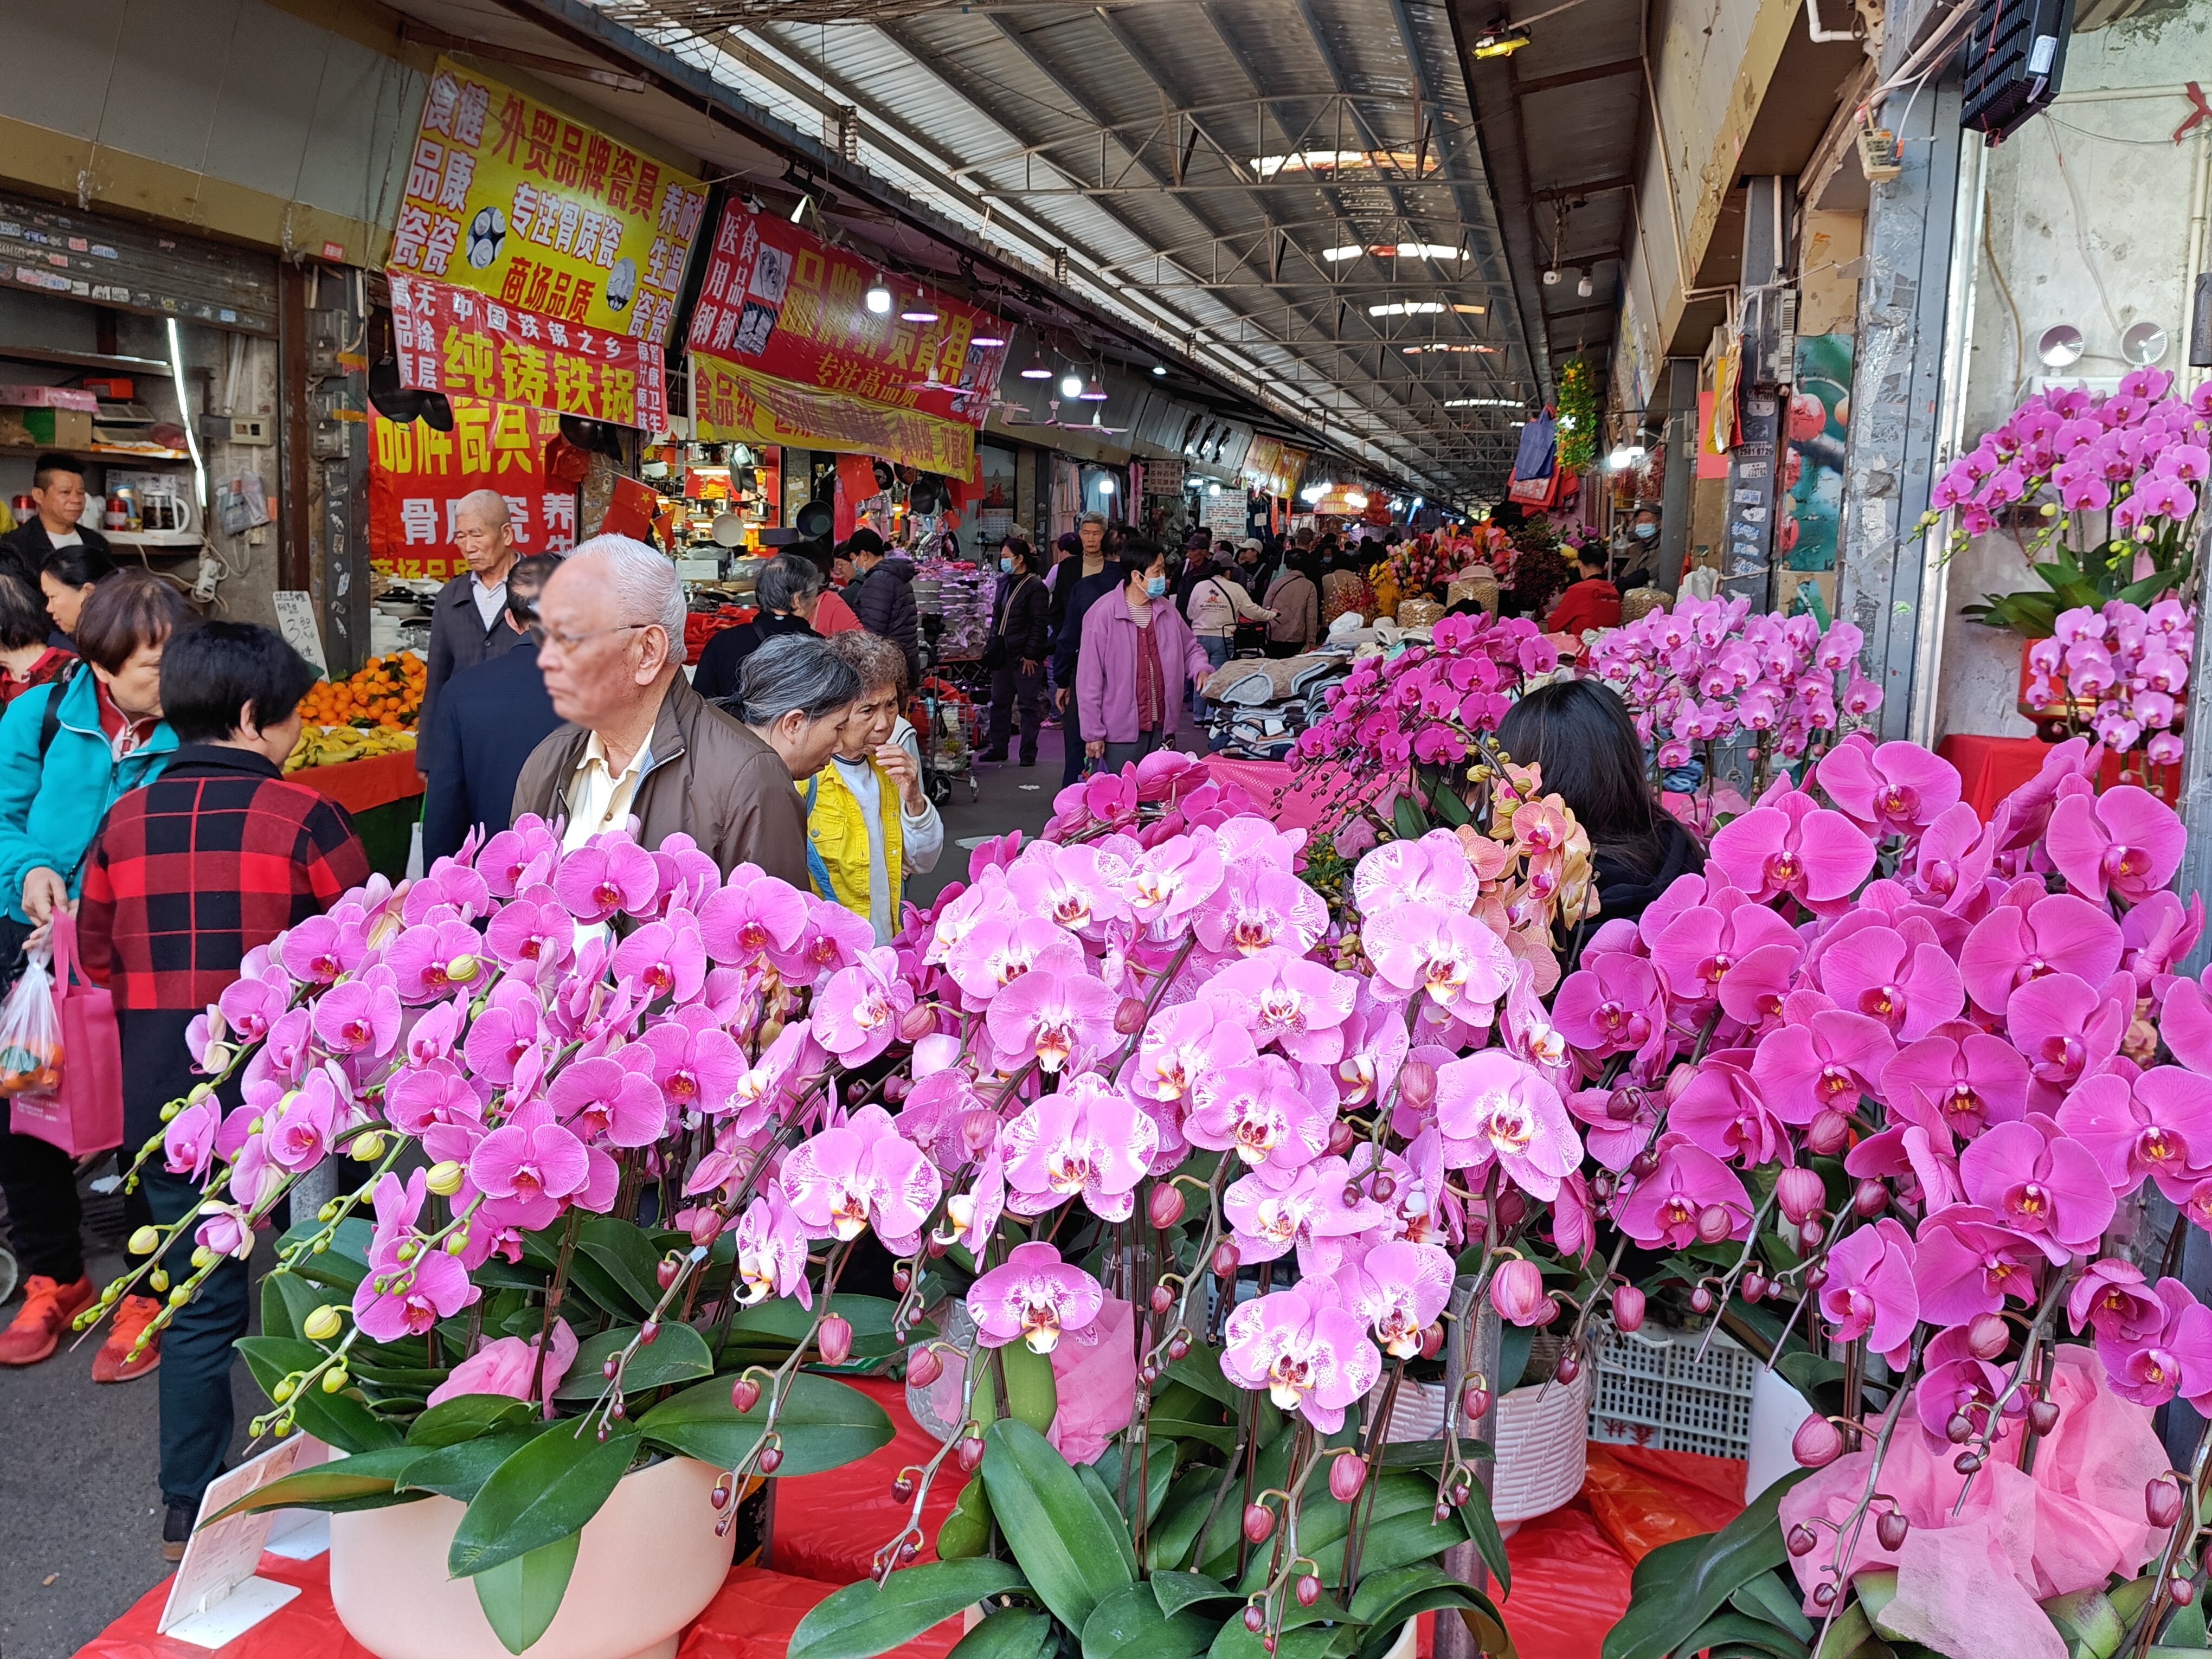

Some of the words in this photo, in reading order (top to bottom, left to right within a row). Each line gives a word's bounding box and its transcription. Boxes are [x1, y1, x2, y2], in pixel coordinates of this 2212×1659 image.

[393, 71, 460, 269] 食品瓷
[421, 80, 490, 276] 健康瓷
[492, 93, 660, 222] 外贸品牌瓷具
[511, 183, 624, 269] 专注骨质瓷
[627, 181, 685, 338] 养生瓷
[415, 283, 438, 390] 无涂层
[453, 291, 621, 359] 中国铁锅之乡
[500, 256, 596, 324] 商场品质
[442, 325, 635, 425] 纯铸铁锅
[637, 340, 650, 430] 原汁原味
[648, 343, 663, 434] 健康卫生
